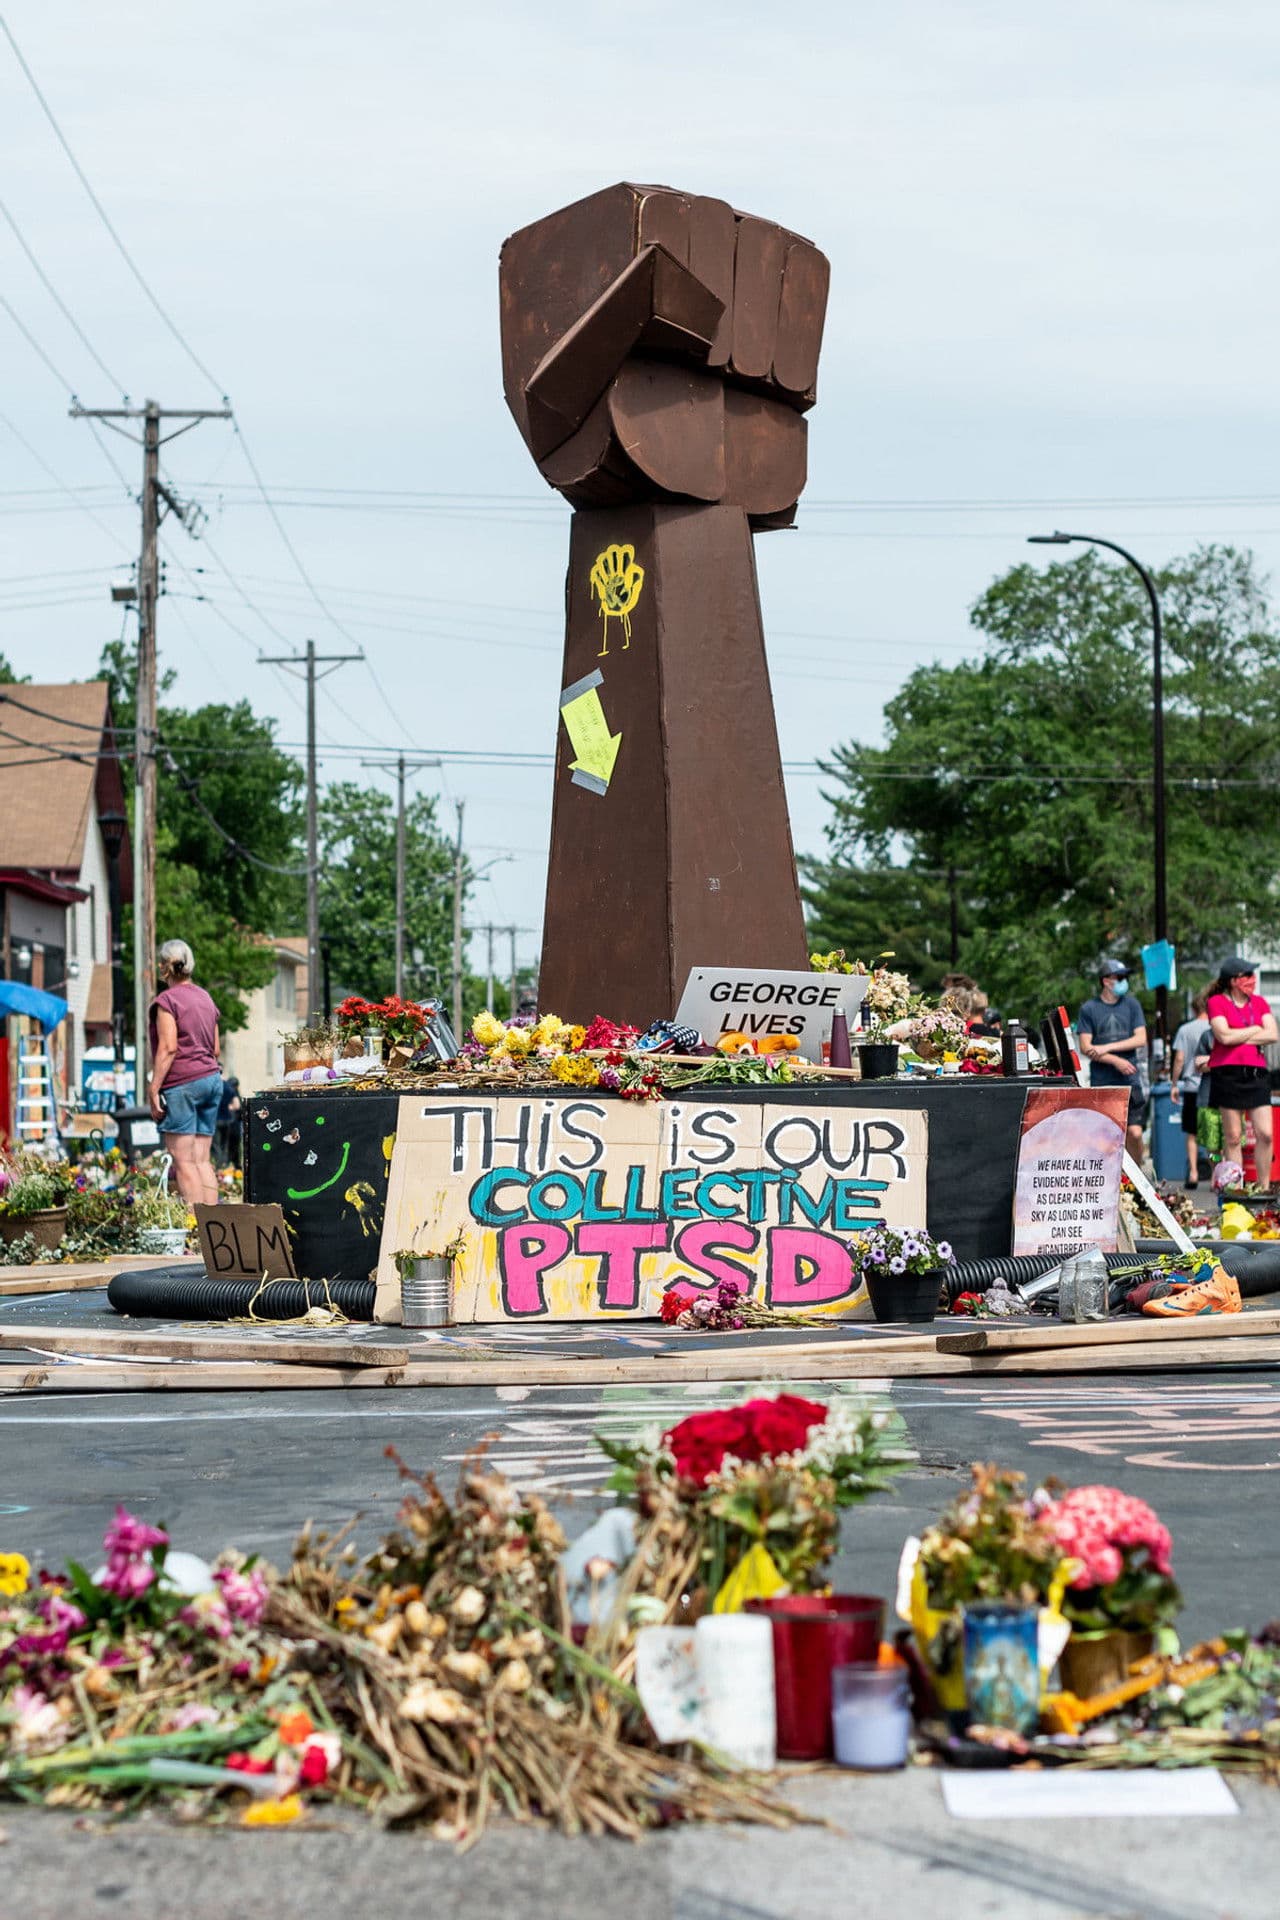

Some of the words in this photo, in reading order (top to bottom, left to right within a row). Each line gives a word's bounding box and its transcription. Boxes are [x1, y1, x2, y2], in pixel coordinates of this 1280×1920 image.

[710, 982, 841, 1006] GEORGE
[720, 1013, 806, 1035] LIVES
[765, 1117, 906, 1178] OUR
[1038, 1160, 1050, 1171] WE
[1051, 1160, 1071, 1171] HAVE
[1073, 1160, 1086, 1170] ALL
[1090, 1159, 1103, 1170] THE
[1033, 1176, 1069, 1188] EVIDENCE
[1072, 1176, 1083, 1187] WE
[1084, 1176, 1104, 1187] NEED
[1037, 1194, 1047, 1204] AS
[1049, 1193, 1072, 1204] CLEAR
[1073, 1193, 1083, 1204] AS
[1085, 1193, 1099, 1203] THE
[1031, 1211, 1045, 1222] SKY
[1047, 1211, 1057, 1221] AS
[1059, 1210, 1078, 1221] LONG
[1080, 1210, 1090, 1220] AS
[1092, 1209, 1103, 1220] WE
[1051, 1227, 1066, 1238] CAN
[1068, 1226, 1082, 1237] SEE
[205, 1221, 295, 1278] BLM
[500, 1220, 863, 1317] PTSD
